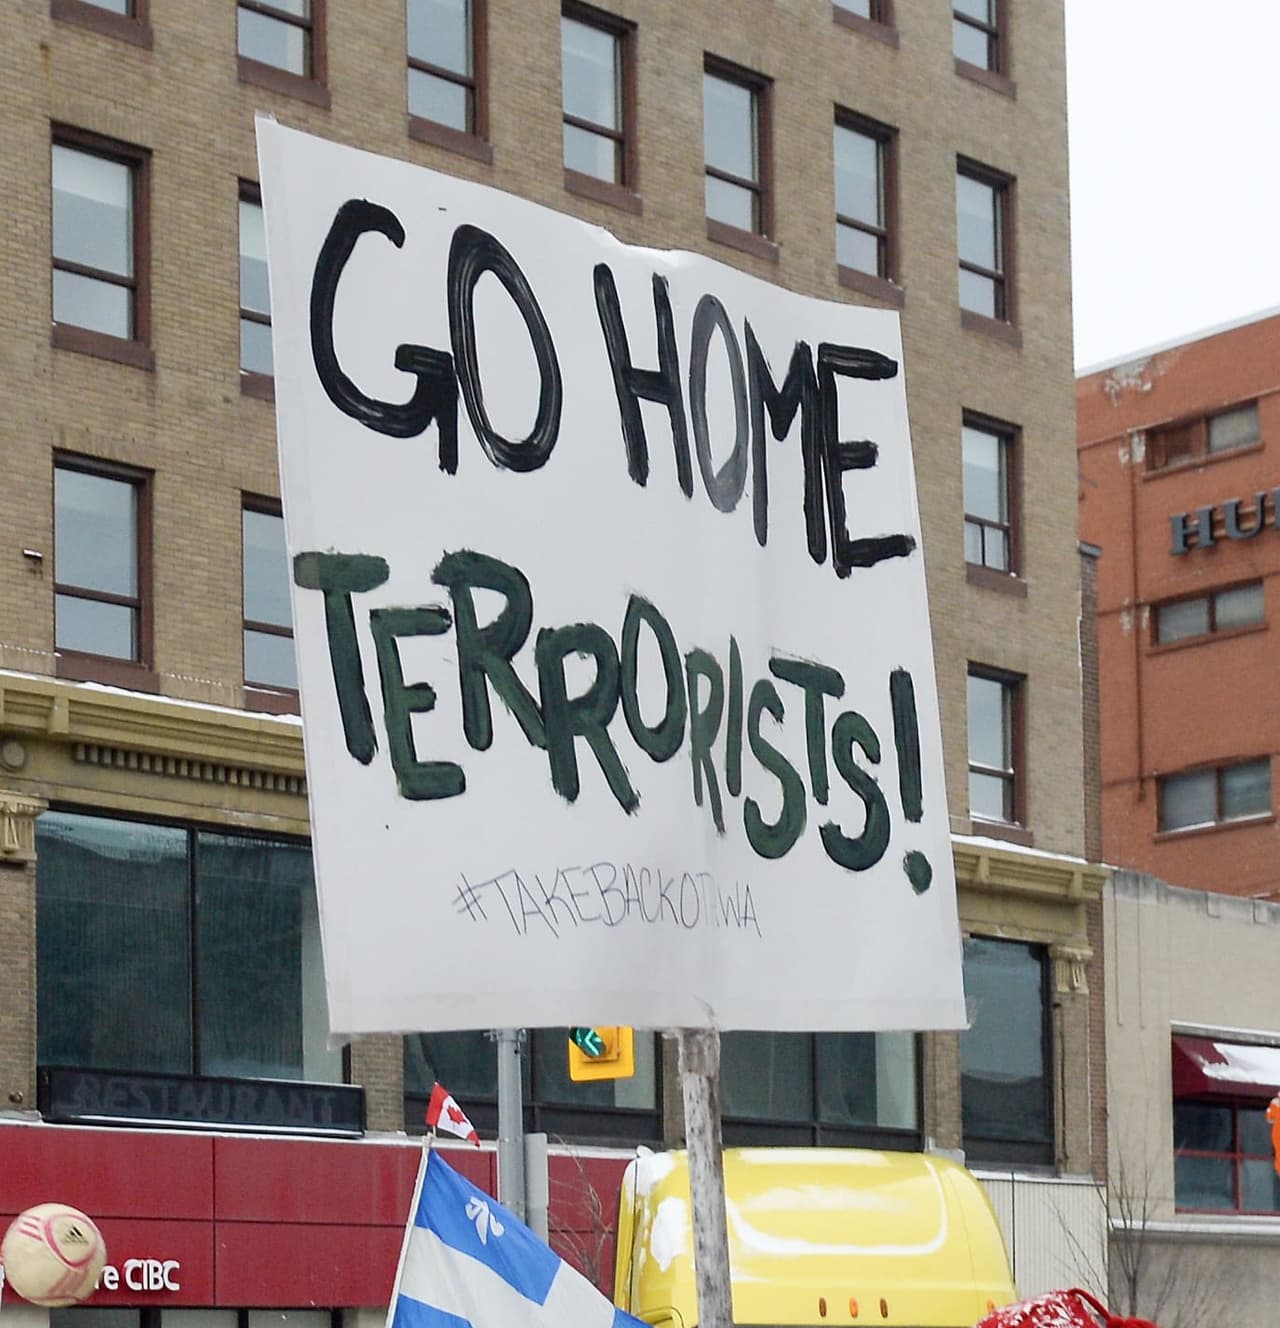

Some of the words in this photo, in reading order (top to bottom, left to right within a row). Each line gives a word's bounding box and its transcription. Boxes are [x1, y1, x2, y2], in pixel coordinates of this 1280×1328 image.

[310, 198, 563, 475] GO
[593, 262, 916, 578] HOME
[293, 549, 933, 895] TERRORISTS!
[452, 861, 762, 938] #TAKEBACKOTWA
[125, 1259, 181, 1291] CIBC
